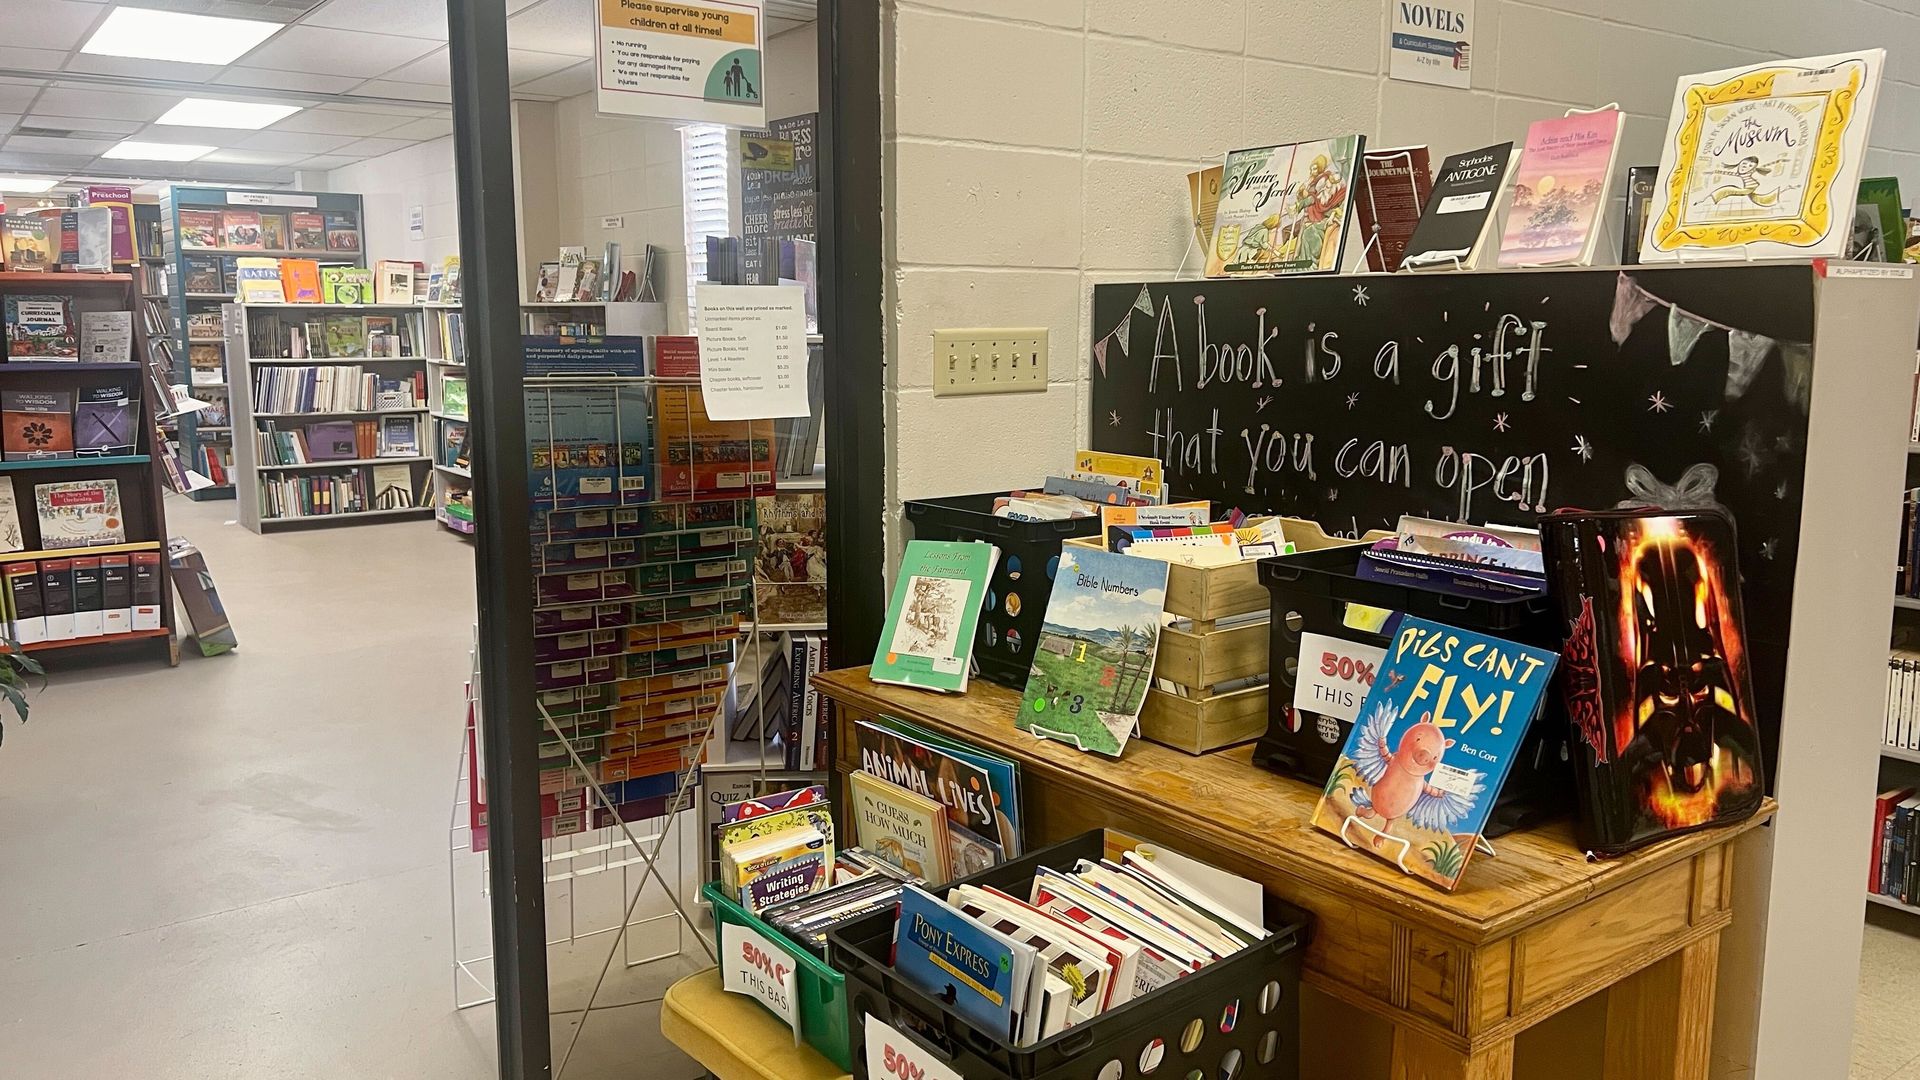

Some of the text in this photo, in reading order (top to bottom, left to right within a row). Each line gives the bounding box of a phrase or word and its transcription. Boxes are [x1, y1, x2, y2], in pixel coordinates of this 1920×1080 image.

[621, 0, 729, 24] Please supervise young
[1399, 2, 1464, 34] NOVELS
[630, 17, 722, 36] children at all times!
[625, 41, 647, 50] running
[626, 61, 638, 69] any
[639, 61, 666, 71] damaged
[667, 64, 682, 72] items
[640, 52, 672, 62] responsible
[682, 58, 700, 66] paying
[1426, 57, 1431, 65] by
[618, 78, 638, 87] injuries
[650, 72, 681, 81] responsible
[1742, 117, 1762, 129] the
[1713, 126, 1796, 156] Museum
[1228, 162, 1278, 199] Squire
[1445, 163, 1498, 182] ANTIGONE
[92, 191, 129, 199] Preschool
[1253, 180, 1297, 212] Scroll
[744, 213, 768, 225] CHEER
[745, 224, 768, 234] more
[244, 269, 277, 278] LATIN
[1148, 294, 1553, 420] A book is a gift
[1146, 407, 1550, 524] that you can open
[763, 508, 815, 519] Rhythms and
[924, 551, 971, 561] Lessons From
[919, 564, 967, 575] the Farmyard
[1076, 573, 1139, 597] Bible Numbers
[1076, 641, 1087, 663] 1
[808, 646, 818, 688] AMERIC
[1320, 651, 1376, 687] 50%
[1463, 644, 1545, 685] CAN'T
[791, 647, 804, 740] EXPLORING AMERICA 2
[1069, 694, 1084, 714] 3
[1313, 684, 1353, 708] THIS
[1399, 663, 1515, 736] FLY!
[1461, 743, 1498, 763] Ben Cort
[710, 791, 739, 805] QUIZ
[876, 800, 909, 825] GUESS
[865, 810, 927, 848] HOW MUCH
[766, 873, 804, 893] Writing
[759, 883, 810, 907] Strategies
[914, 912, 942, 947] PONY
[945, 931, 990, 979] EXPRESS
[743, 941, 774, 979] 50%
[740, 970, 765, 994] THIS
[883, 1043, 926, 1080] 50%
